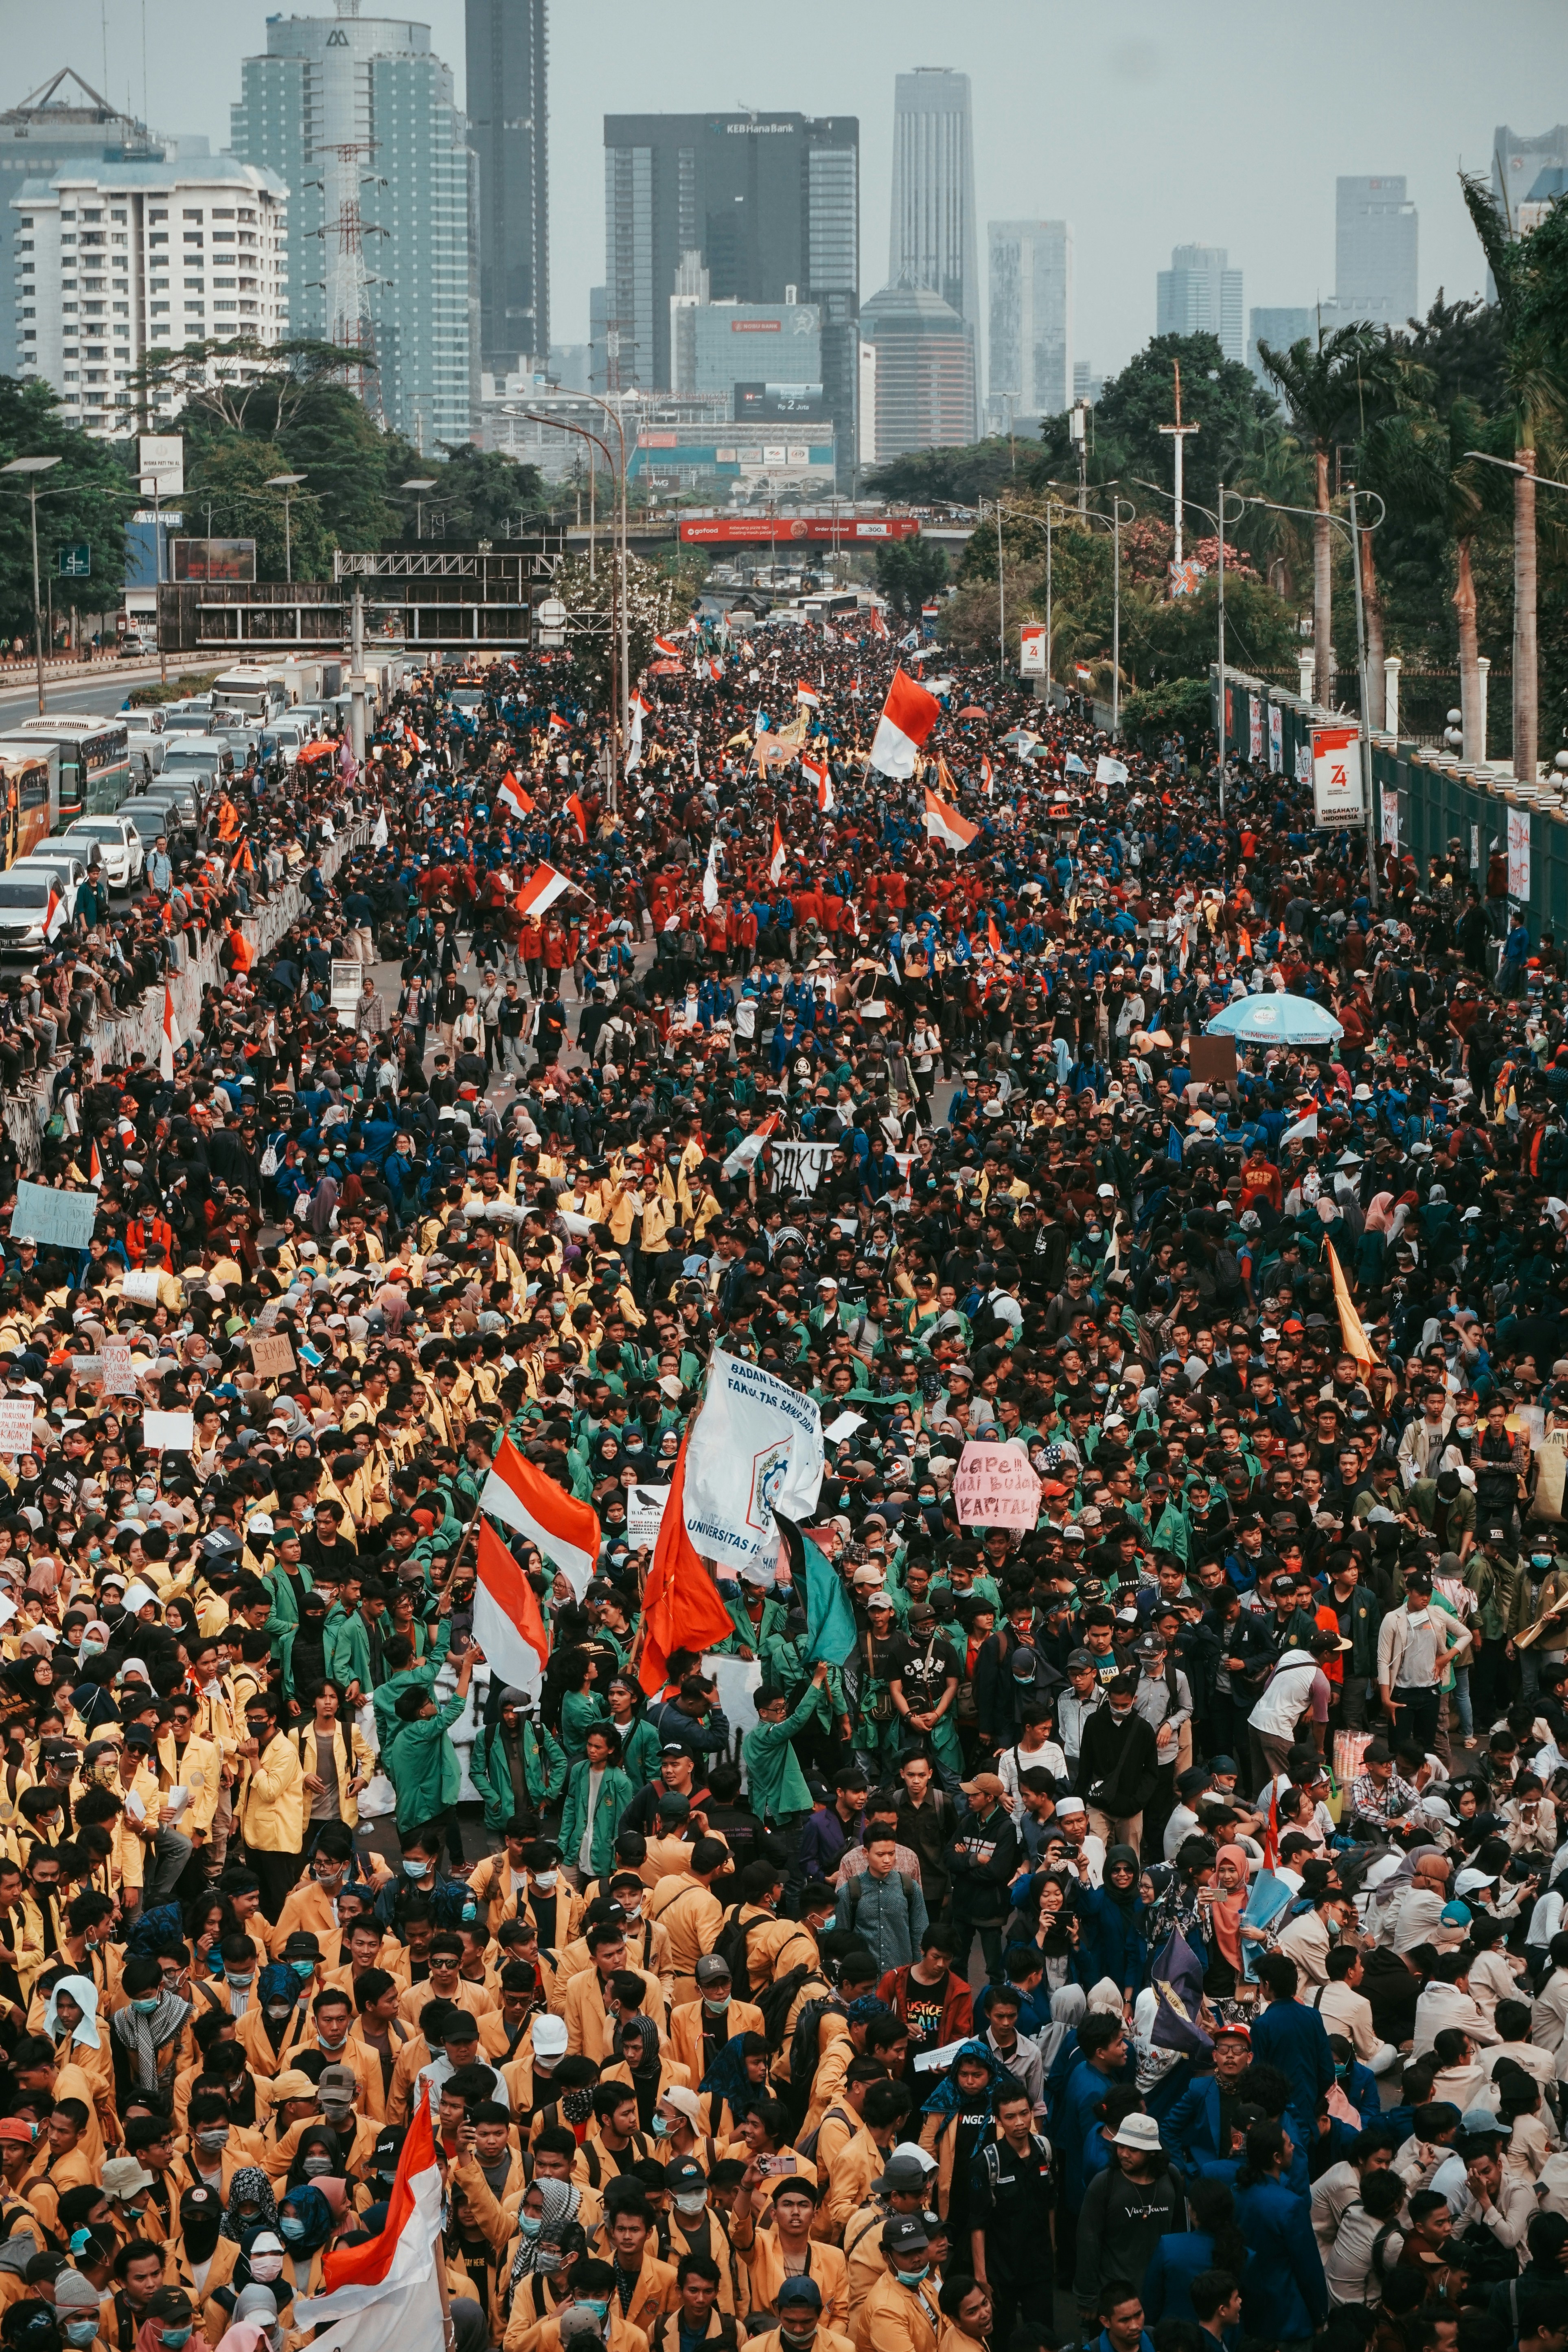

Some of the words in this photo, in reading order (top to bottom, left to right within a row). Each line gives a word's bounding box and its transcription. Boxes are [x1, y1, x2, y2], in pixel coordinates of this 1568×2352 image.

[727, 124, 745, 134] KEB
[746, 124, 770, 133] Hana
[771, 124, 794, 133] Bank
[787, 400, 795, 410] 2
[1029, 646, 1038, 657] 74
[1331, 765, 1347, 786] 74
[1250, 1031, 1279, 1040] Minerale
[101, 1348, 130, 1365] NOBODY
[731, 1364, 766, 1384] BADAN
[105, 1383, 121, 1392] FUCKS
[728, 1378, 777, 1407] FAKULTAS
[688, 1519, 749, 1550] UNIVERSITAS
[377, 2142, 394, 2152] Bloods
[473, 2258, 484, 2266] HERE
